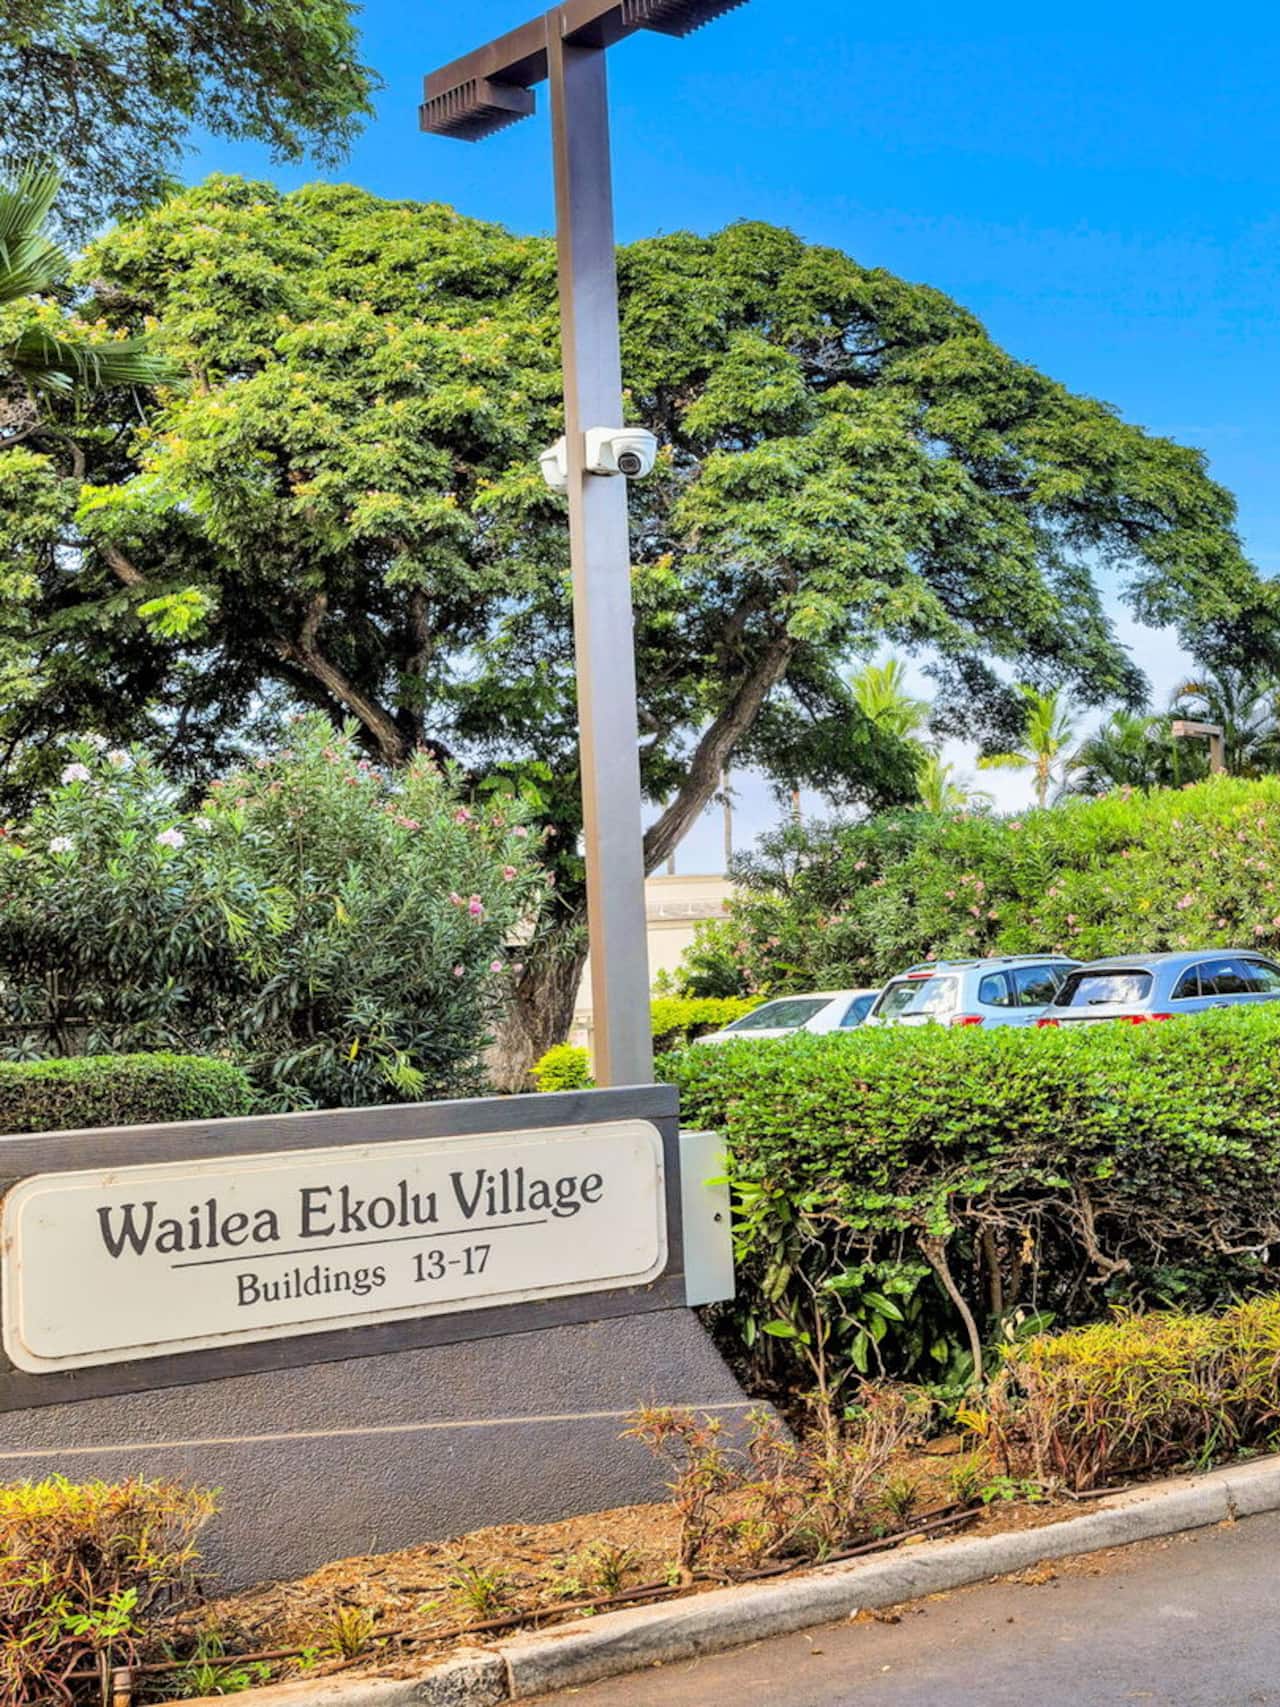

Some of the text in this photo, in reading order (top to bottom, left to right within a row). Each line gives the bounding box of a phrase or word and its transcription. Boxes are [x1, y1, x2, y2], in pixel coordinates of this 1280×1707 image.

[96, 1166, 604, 1259] Wailea Ekolu Village
[236, 1244, 492, 1307] Buildings 13-17
